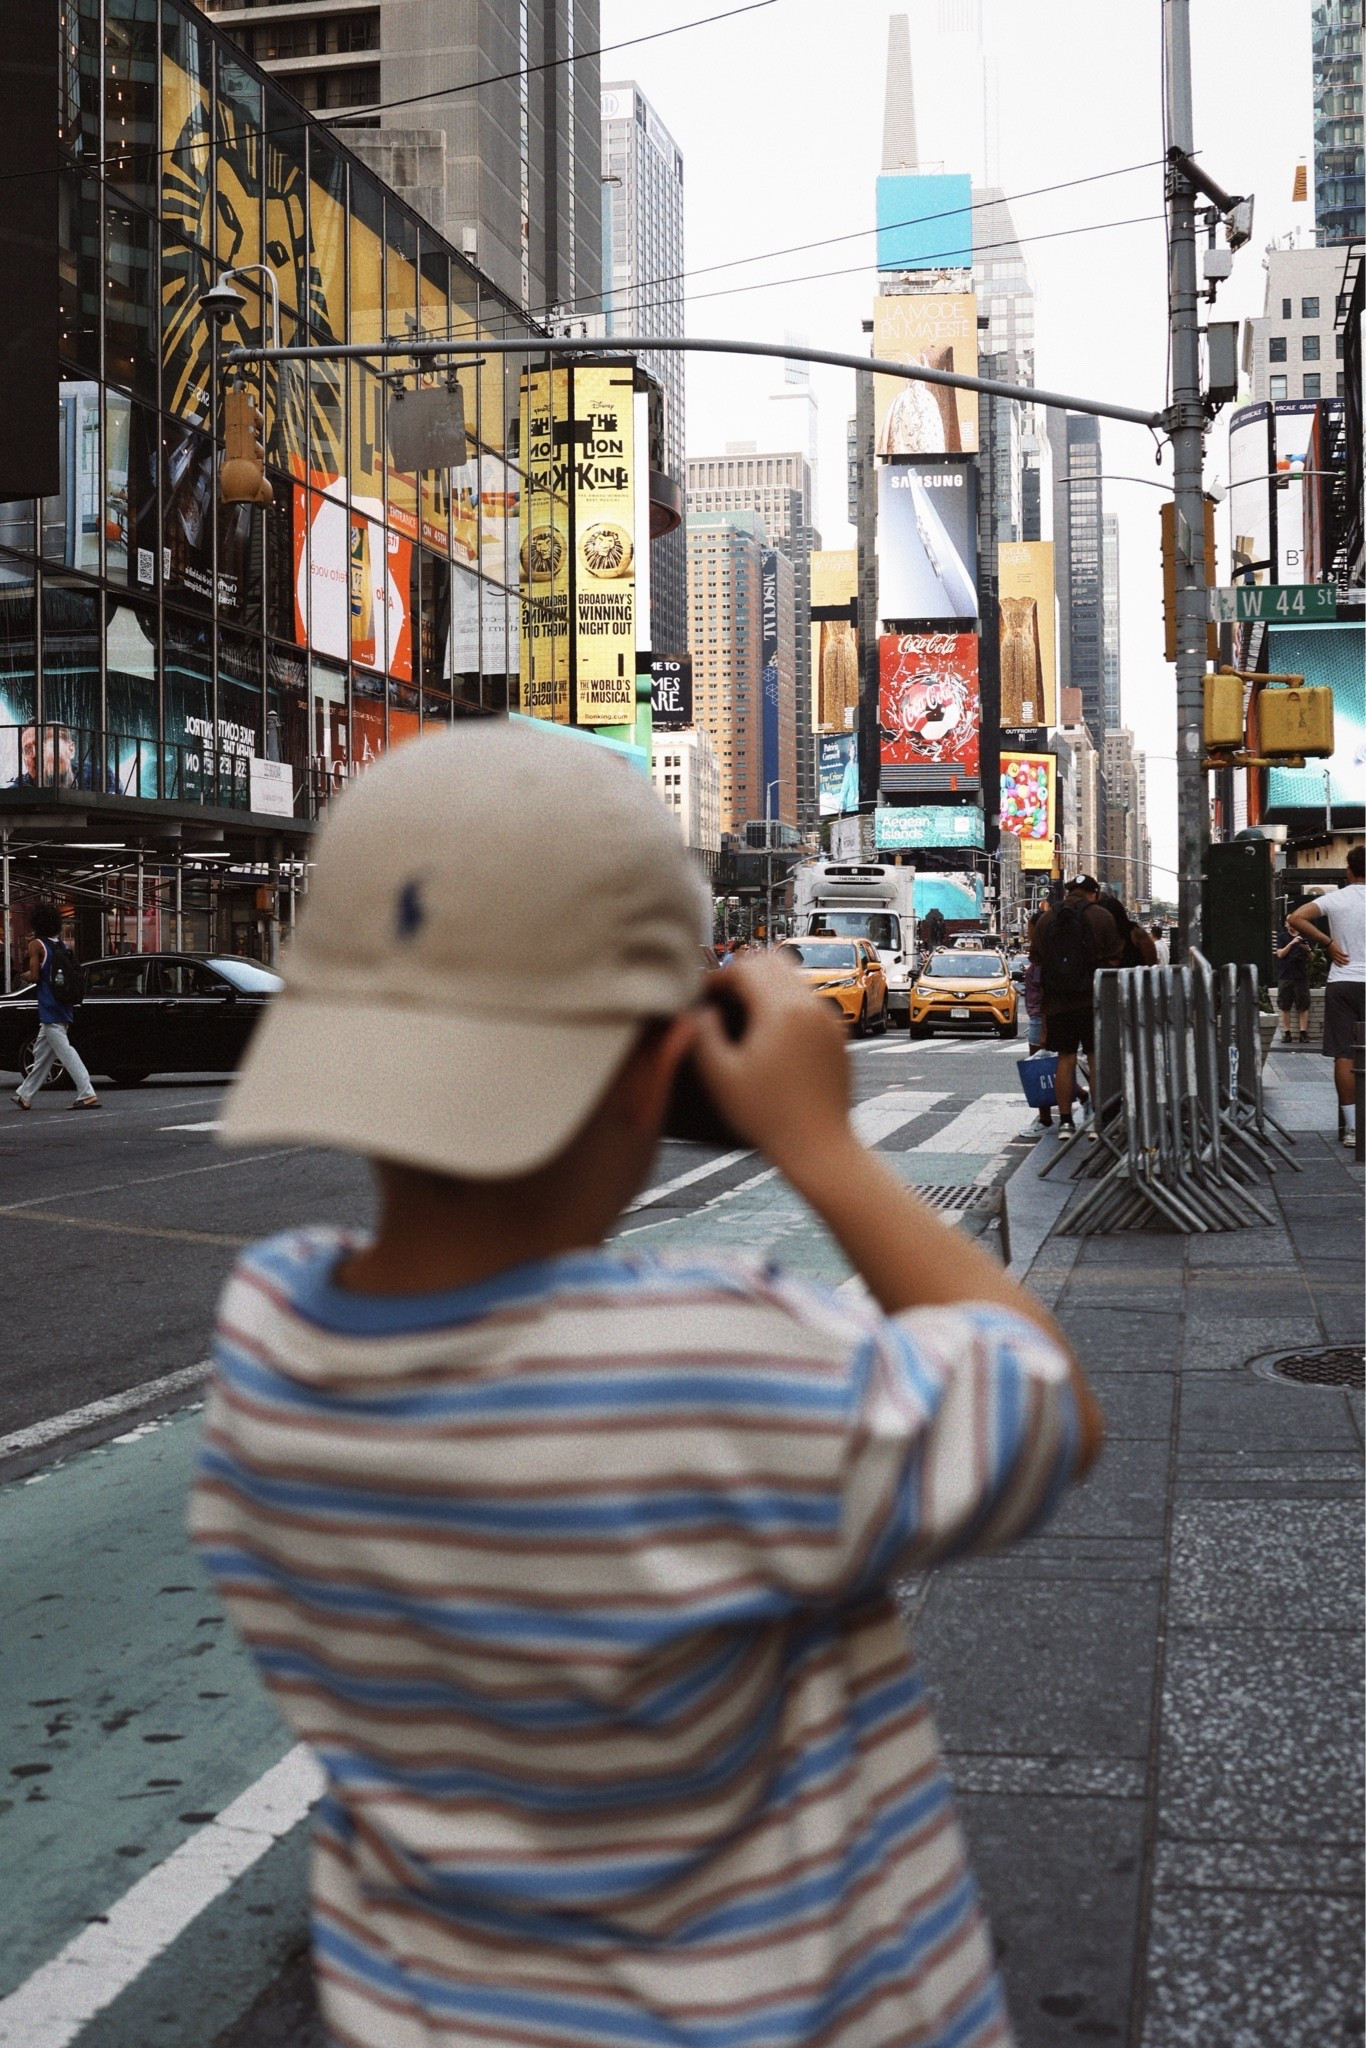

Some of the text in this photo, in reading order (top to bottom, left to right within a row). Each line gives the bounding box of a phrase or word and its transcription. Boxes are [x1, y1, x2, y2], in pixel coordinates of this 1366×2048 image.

[907, 301, 965, 322] MODE
[587, 413, 618, 432] THE
[583, 438, 623, 460] LION
[891, 474, 963, 490] SAMSUNG
[423, 525, 432, 537] ON
[434, 530, 447, 546] 45TH
[578, 593, 633, 605] BROADWAY'S
[1242, 588, 1333, 617] W 44 St
[579, 605, 632, 621] WINNING
[579, 621, 632, 635] NIGHT OUT
[898, 633, 959, 655] Coca-Cola
[664, 662, 681, 671] TO
[580, 679, 631, 691] THE WORLD'S
[591, 691, 631, 704] MUSICAL
[882, 816, 930, 830] Aegean
[882, 828, 924, 840] Islands
[1040, 1073, 1057, 1089] GA
